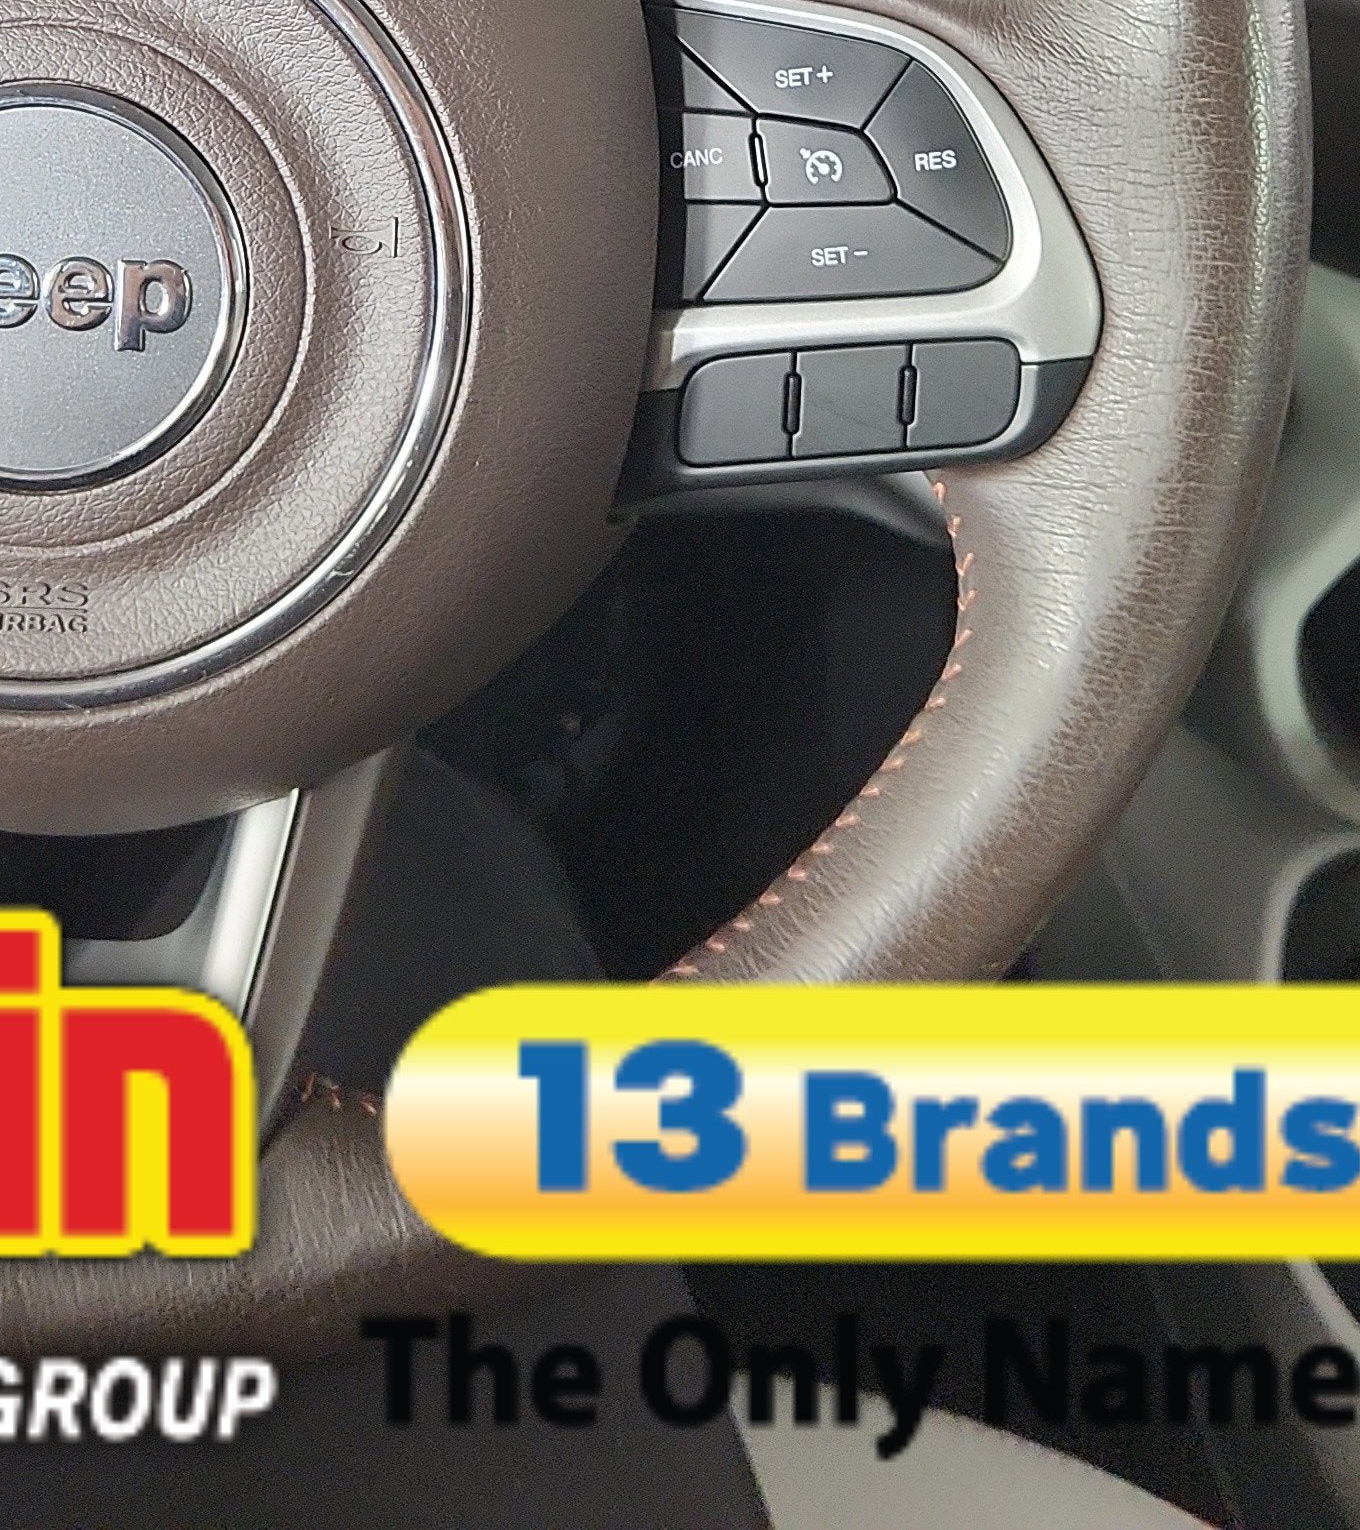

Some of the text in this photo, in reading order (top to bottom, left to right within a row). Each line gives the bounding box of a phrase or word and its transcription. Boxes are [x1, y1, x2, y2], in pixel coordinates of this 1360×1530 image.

[775, 68, 812, 89] SET
[670, 148, 723, 169] CANC
[914, 150, 958, 172] RES
[811, 247, 848, 267] SET
